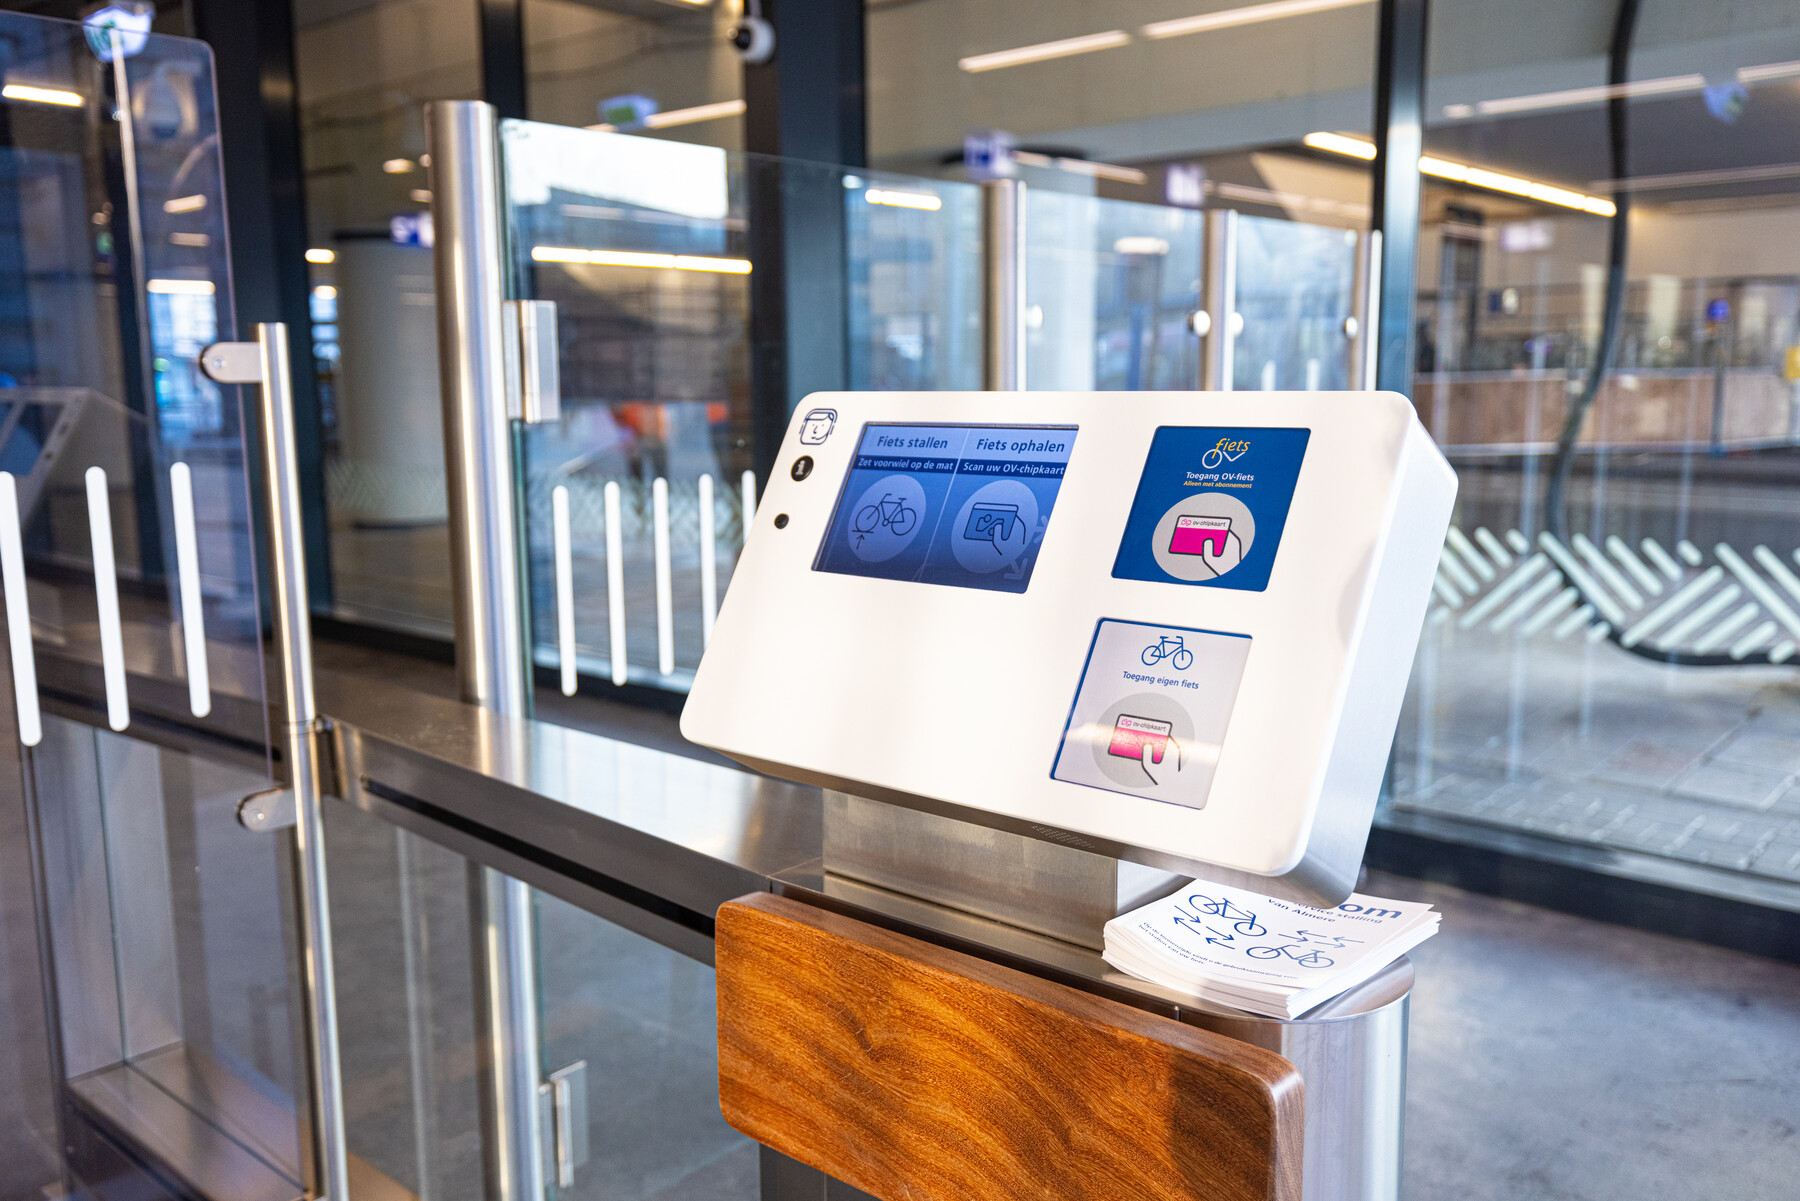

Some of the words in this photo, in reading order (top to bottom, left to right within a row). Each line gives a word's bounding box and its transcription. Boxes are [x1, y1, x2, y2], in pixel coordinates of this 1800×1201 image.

[877, 436, 904, 447] Fiets
[907, 436, 948, 449] stallen
[976, 438, 1007, 451] Fiets
[1011, 439, 1065, 454] ophalen
[1211, 438, 1251, 459] fiets
[858, 457, 872, 467] Zet
[873, 459, 910, 468] voorwiel
[910, 461, 922, 470] op
[923, 460, 934, 469] de
[936, 462, 953, 470] mat
[963, 462, 984, 471] Scan
[986, 464, 1001, 472] uw
[1003, 463, 1065, 476] OV-chipkaart
[1186, 471, 1219, 481] Toegang
[1221, 472, 1255, 481] OV-fiets
[1215, 481, 1253, 489] abonnement
[1123, 671, 1155, 684] Toegang
[1156, 677, 1180, 687] eigen
[1181, 679, 1199, 689] fiets
[1268, 898, 1289, 910] van
[1292, 909, 1336, 923] Almere
[1338, 903, 1403, 919] om
[1336, 912, 1383, 924] stalling
